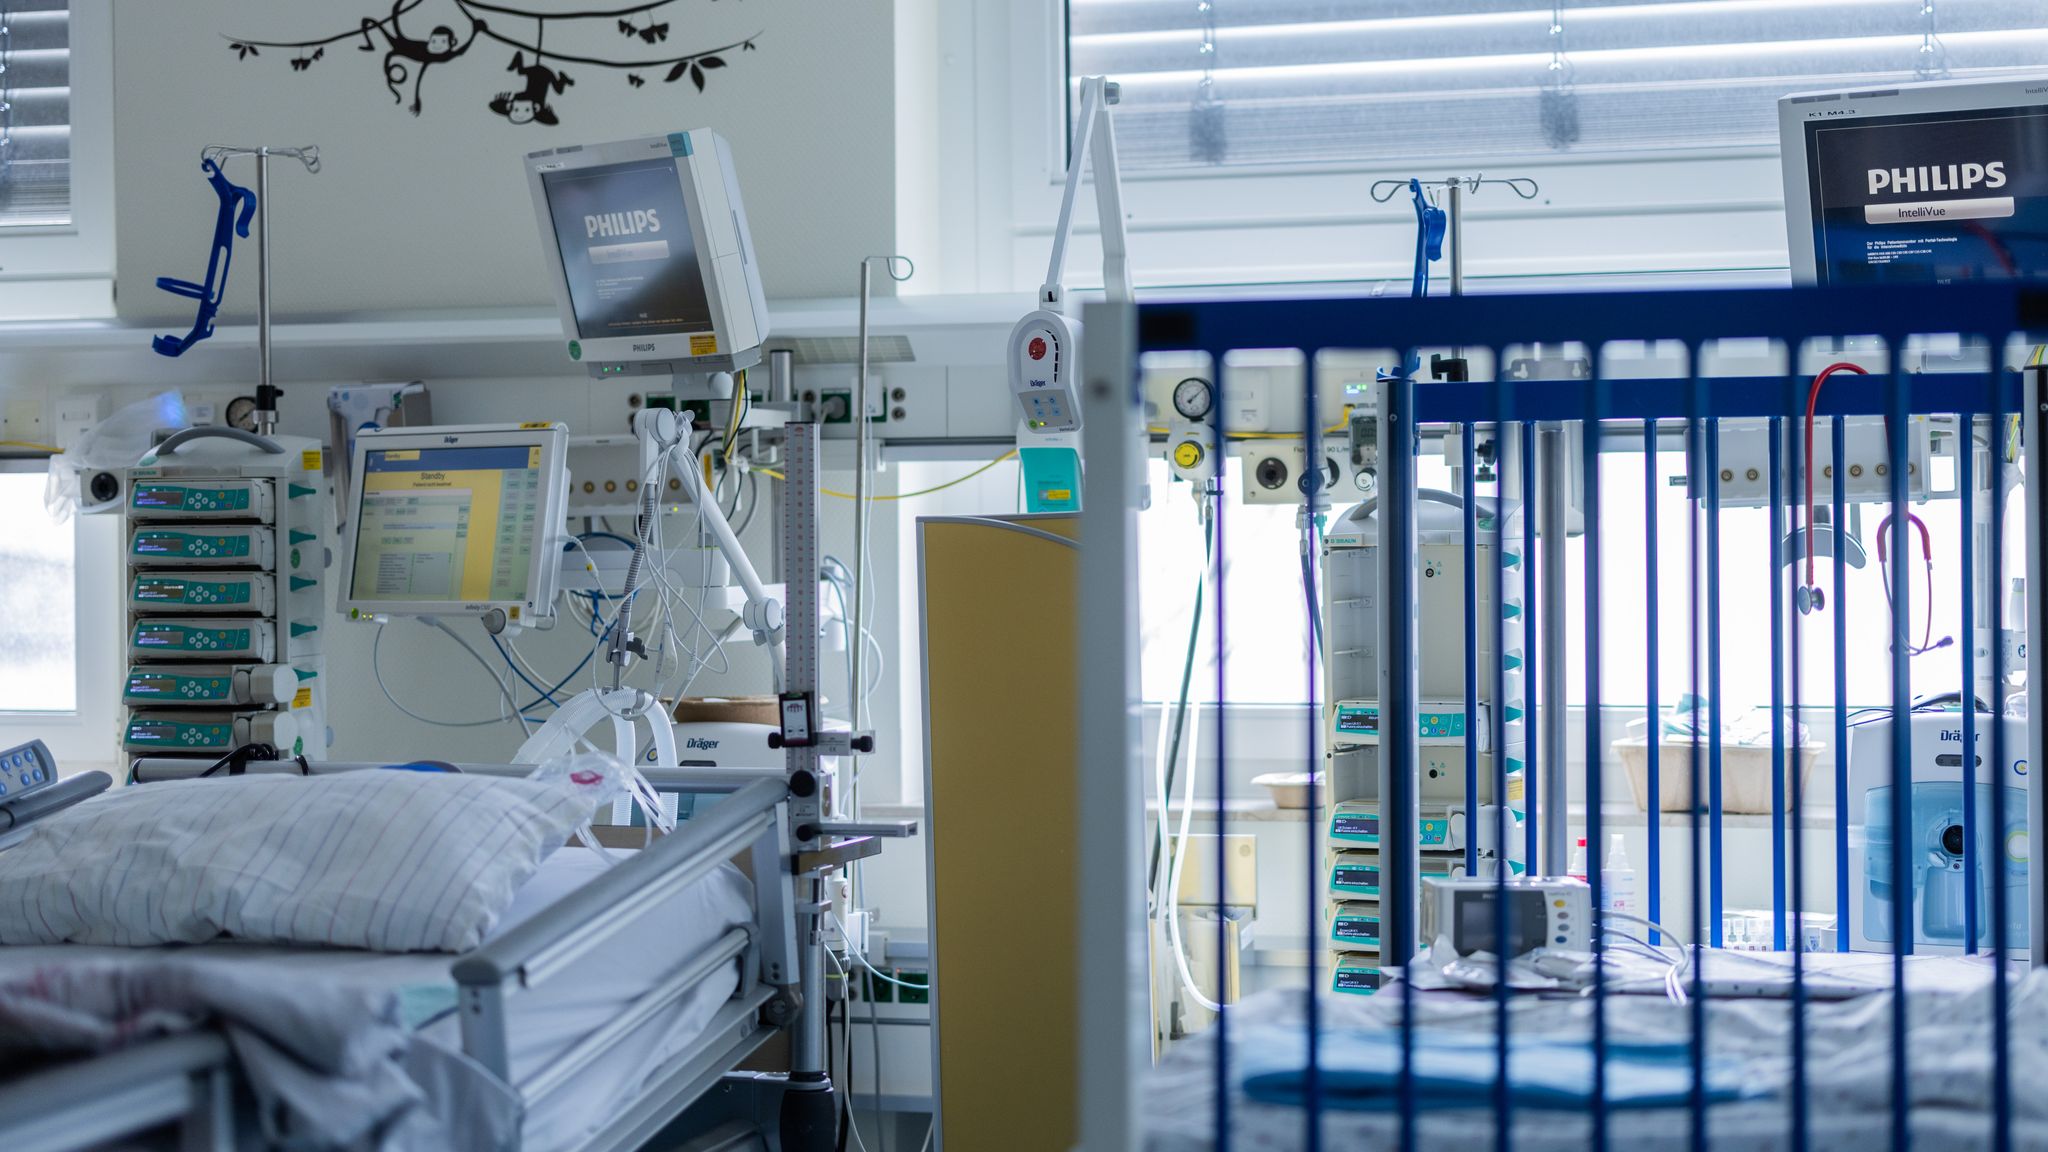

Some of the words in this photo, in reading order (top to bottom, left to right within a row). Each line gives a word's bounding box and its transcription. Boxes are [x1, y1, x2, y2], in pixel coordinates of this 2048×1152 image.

[1867, 161, 2007, 195] PHILIPS
[1898, 205, 1946, 219] IntelliVue
[584, 208, 661, 239] PHILIPS
[632, 343, 656, 352] PHILIPS
[421, 472, 446, 481] Standby
[1940, 730, 1980, 743] Drär
[686, 737, 720, 751] Dräger
